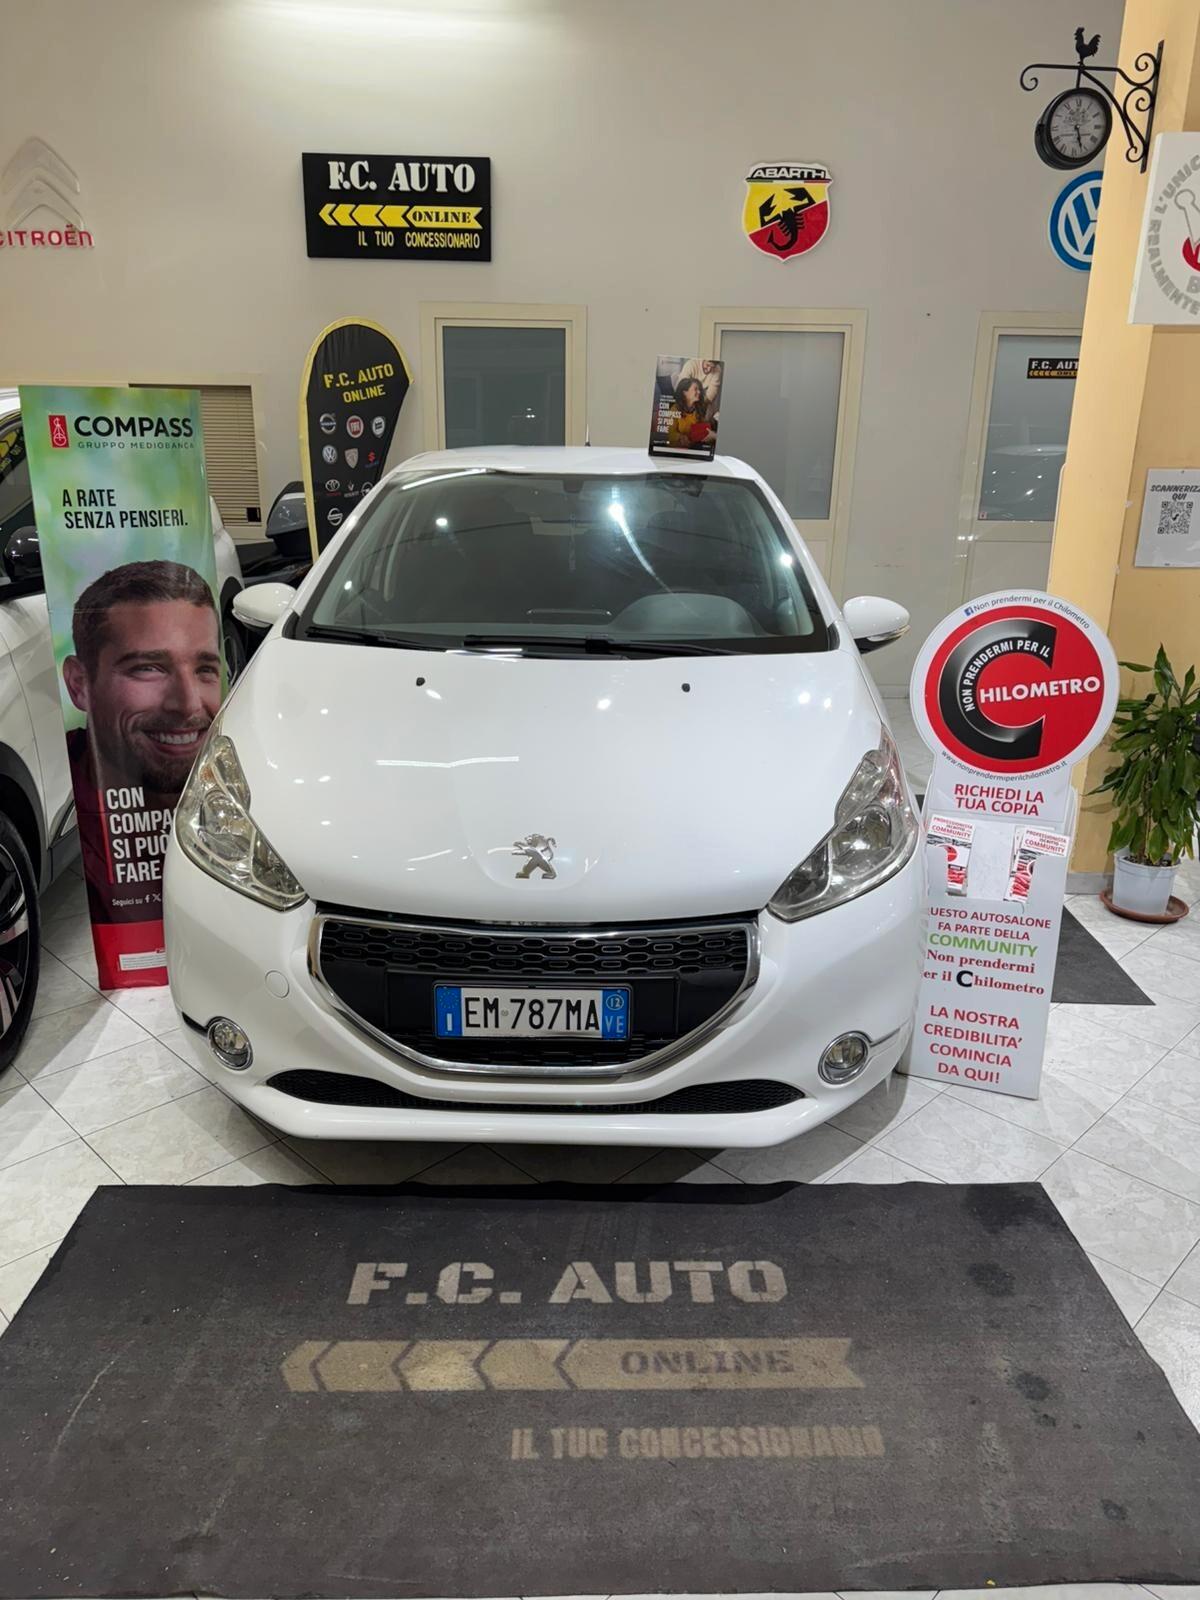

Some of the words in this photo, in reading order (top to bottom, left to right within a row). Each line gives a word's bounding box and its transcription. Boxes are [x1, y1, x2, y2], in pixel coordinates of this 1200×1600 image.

[328, 160, 378, 190] F.C.
[388, 162, 476, 193] AUTO
[752, 167, 825, 179] ABARTH
[412, 210, 471, 223] ONLINE
[358, 230, 368, 246] IL
[375, 231, 394, 247] TUO
[405, 231, 481, 248] CONCESSIONARIO
[323, 373, 354, 388] F.C.
[358, 363, 394, 384] AUTO
[342, 384, 386, 403] ONLINE
[74, 416, 194, 437] COMPASS
[78, 441, 125, 449] GRUPPO
[130, 441, 194, 449] MEDIOBANCA
[62, 489, 72, 507] A
[77, 489, 116, 507] RATE
[64, 511, 115, 529] SENZA
[120, 509, 188, 528] PENSIERI.
[973, 602, 990, 612] Non
[991, 595, 1032, 607] prendermi
[1054, 602, 1090, 629] Chilometro
[1017, 640, 1038, 652] PER
[1039, 645, 1051, 657] IL
[963, 640, 1013, 686] PRENDERMI
[962, 688, 975, 712] NON
[106, 786, 145, 810] CON
[954, 784, 1021, 801] RICHIEDI
[1025, 790, 1044, 803] LA
[955, 797, 987, 811] TUA
[991, 800, 1039, 816] COPIA
[109, 808, 177, 834] COMPA
[112, 838, 131, 859] SI
[135, 829, 170, 858] PUÒ
[115, 860, 162, 884] FARE
[937, 921, 951, 931] FA
[955, 923, 990, 937] PARTE
[994, 928, 1030, 941] DELLA
[971, 911, 1051, 929] AUTOSALONE
[929, 933, 1038, 958] COMMUNITY
[927, 949, 955, 963] Non
[959, 952, 1035, 974] prendermi
[921, 970, 938, 980] er
[942, 971, 952, 982] il
[956, 970, 1045, 995] Chilometro
[465, 997, 499, 1028] EM
[510, 998, 600, 1030] 787MA
[610, 997, 620, 1007] 12
[605, 1016, 624, 1033] VE
[930, 1005, 948, 1019] LA
[953, 1008, 1020, 1029] NOSTRA
[929, 1043, 1012, 1067] COMINCIA
[937, 1062, 960, 1077] DA
[964, 1067, 1000, 1084] QUI!
[347, 1261, 522, 1304] F.C.
[548, 1260, 789, 1304] AUTO
[620, 1349, 796, 1376] ONLINE
[510, 1427, 539, 1460] IL
